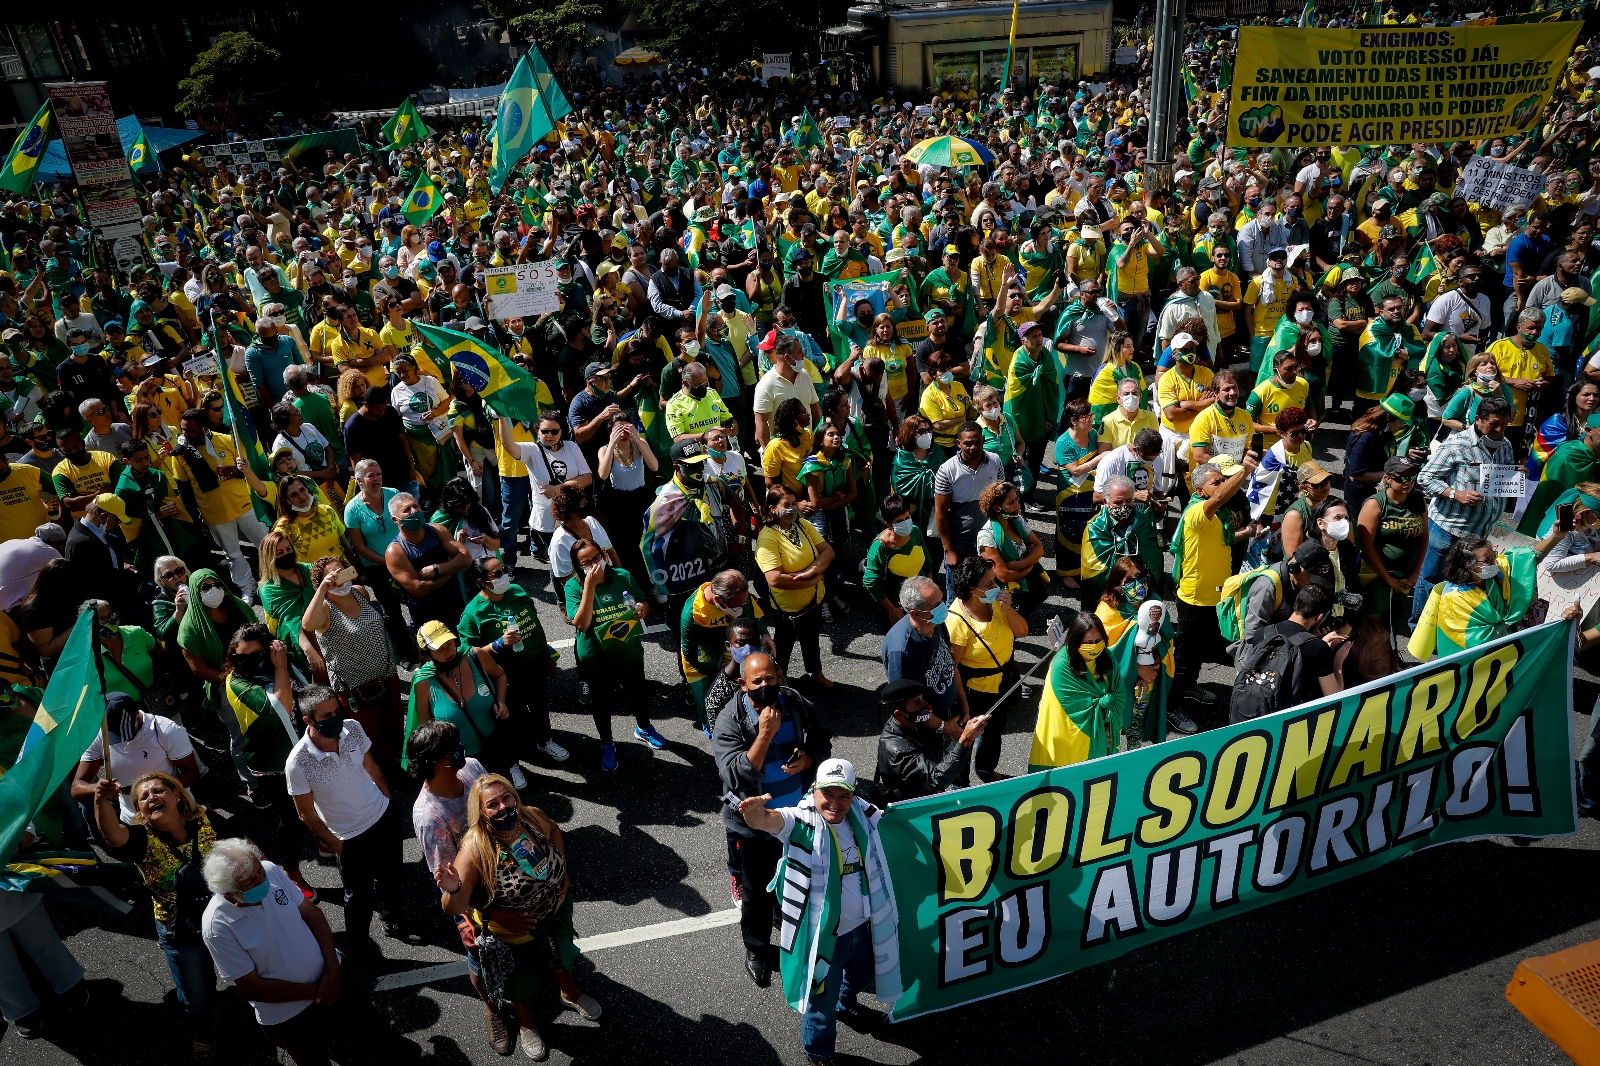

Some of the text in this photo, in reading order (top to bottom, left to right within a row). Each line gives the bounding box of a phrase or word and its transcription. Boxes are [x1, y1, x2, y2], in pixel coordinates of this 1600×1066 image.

[1359, 30, 1455, 48] EXIGIMOS:
[1318, 45, 1500, 66] VOTO IMPRESSO JÁ!
[1255, 58, 1552, 84] SANEAMENTO DAS INSTITUIÇÕES
[1240, 85, 1280, 102] FIM
[1283, 86, 1311, 102] DA
[1314, 84, 1431, 102] IMPUNIDADE
[1434, 84, 1444, 99] E
[1302, 98, 1506, 120] BOLSONARO NO PODER
[1242, 113, 1281, 132] TMJ
[1287, 114, 1510, 144] PODE AGIR PRESIDENTE!
[1475, 159, 1491, 169] SÓ
[1468, 168, 1542, 184] 11 MINISTROS
[1472, 186, 1515, 203] DESTRUIR
[1473, 177, 1536, 200] NÃO PODEM
[1523, 182, 1542, 191] STF
[1453, 189, 1467, 198] UM
[1468, 194, 1492, 207] PAÍS
[71, 374, 85, 385] 10
[1267, 403, 1280, 413] 10
[669, 557, 706, 582] 2022
[596, 605, 618, 615] BRASIL
[931, 639, 1524, 906] BOLSONARO
[938, 709, 1541, 988] EU AUTORIZO!
